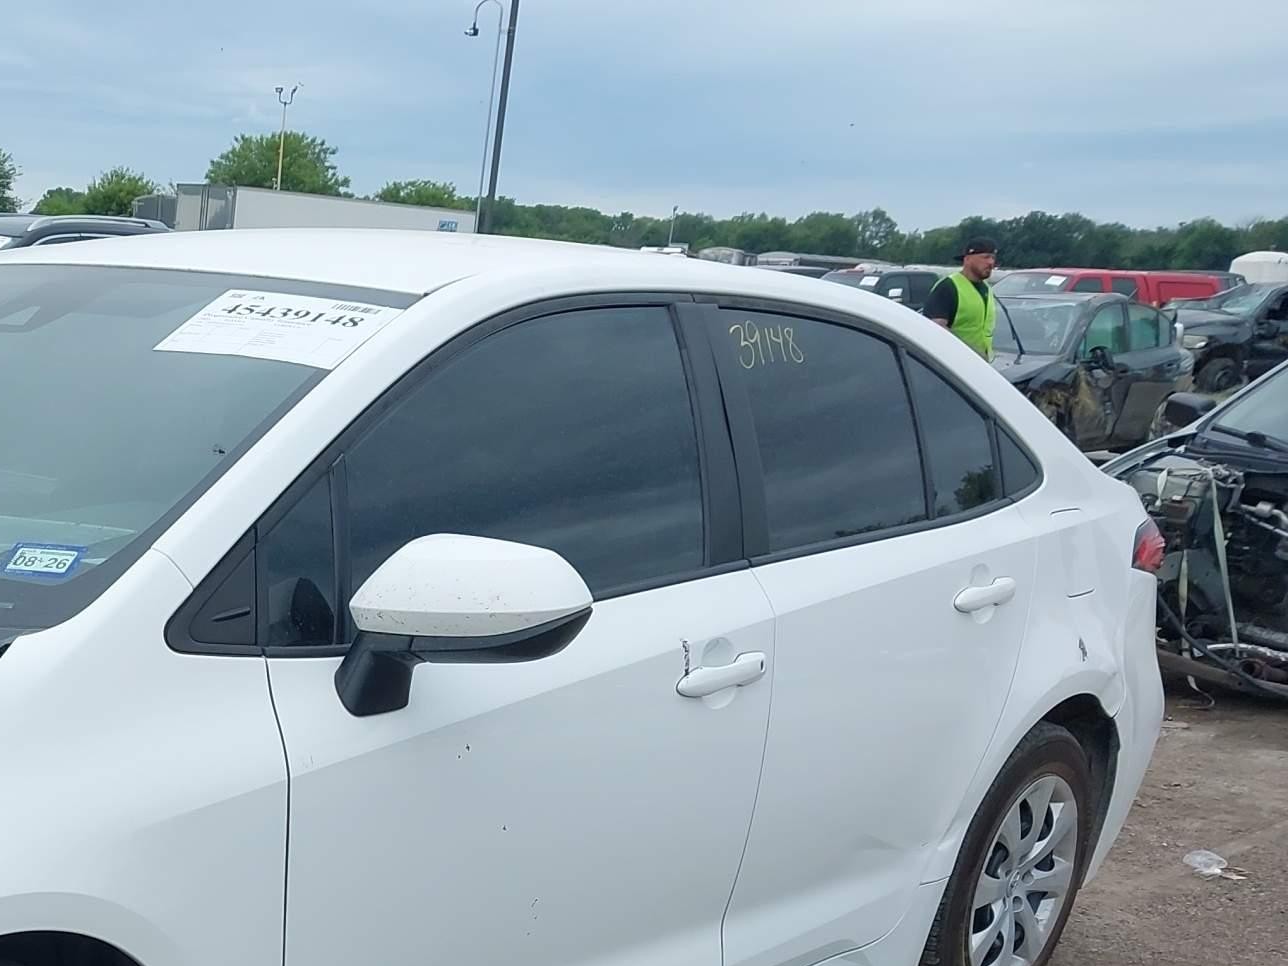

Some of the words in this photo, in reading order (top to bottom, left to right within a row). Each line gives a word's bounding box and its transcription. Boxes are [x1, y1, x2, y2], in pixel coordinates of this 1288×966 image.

[222, 303, 365, 328] 45439148
[729, 320, 804, 369] 39148
[13, 555, 37, 567] 08
[43, 558, 70, 570] 26
